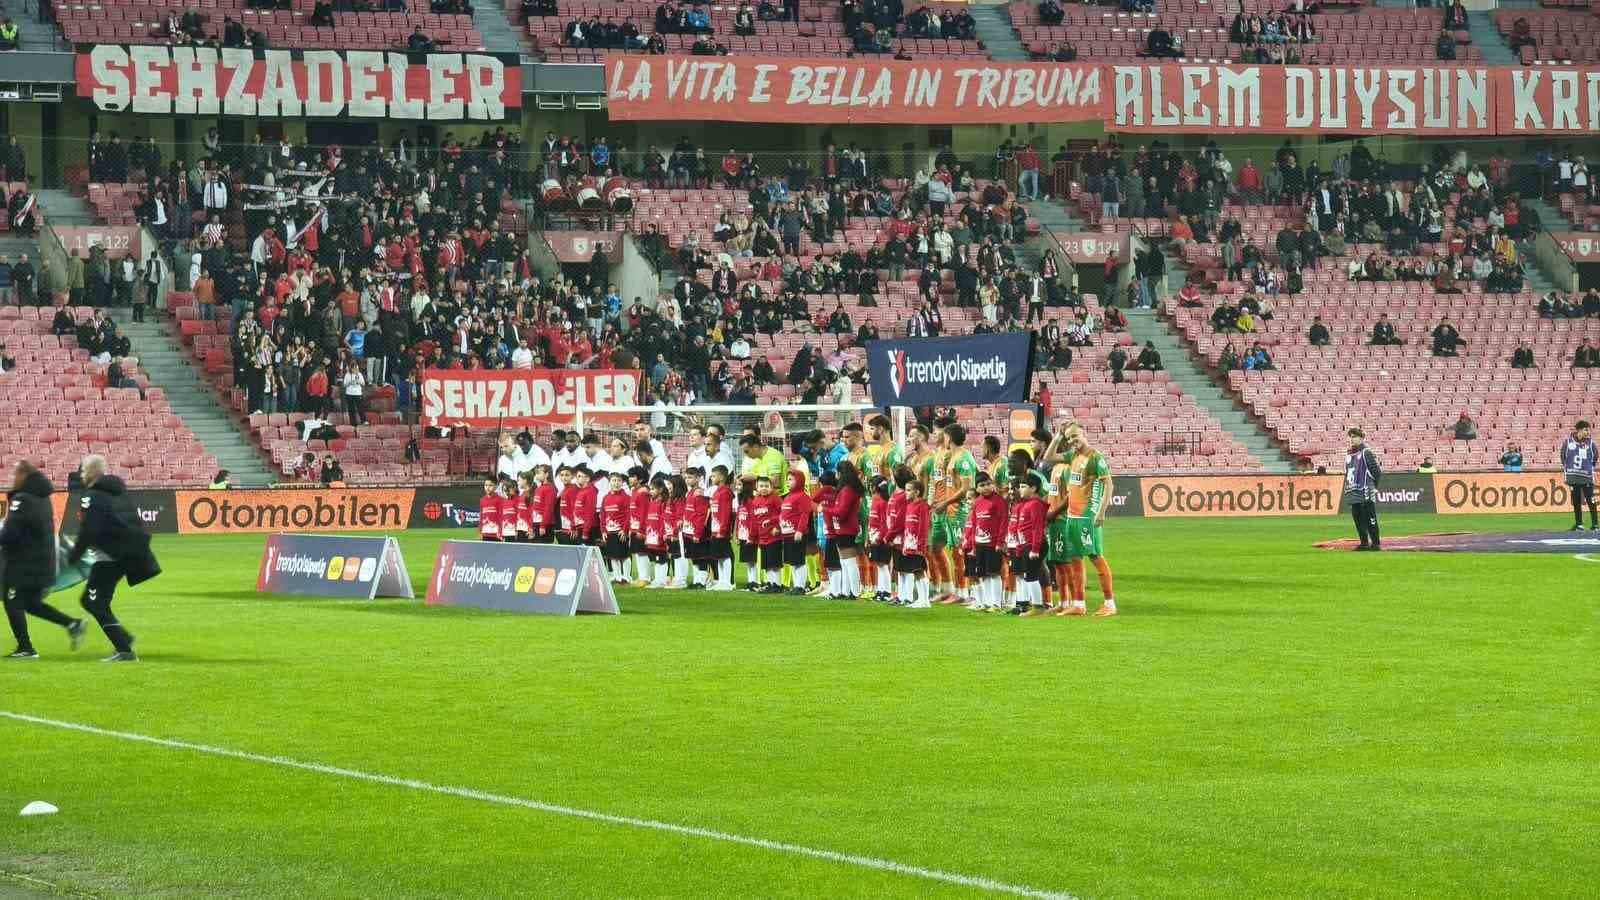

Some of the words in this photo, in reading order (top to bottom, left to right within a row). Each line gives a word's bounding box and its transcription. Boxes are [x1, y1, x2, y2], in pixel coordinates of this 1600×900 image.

[608, 59, 652, 101] LA
[667, 58, 737, 103] VITA
[748, 64, 779, 103] E
[786, 65, 893, 107] BELLA
[904, 67, 943, 107] IN
[954, 67, 1102, 109] TRIBUNA
[1284, 67, 1488, 130] DUYSUN
[188, 495, 401, 529] Otomobilen
[1147, 482, 1334, 512] Otomobilen
[1376, 488, 1420, 502] unalar
